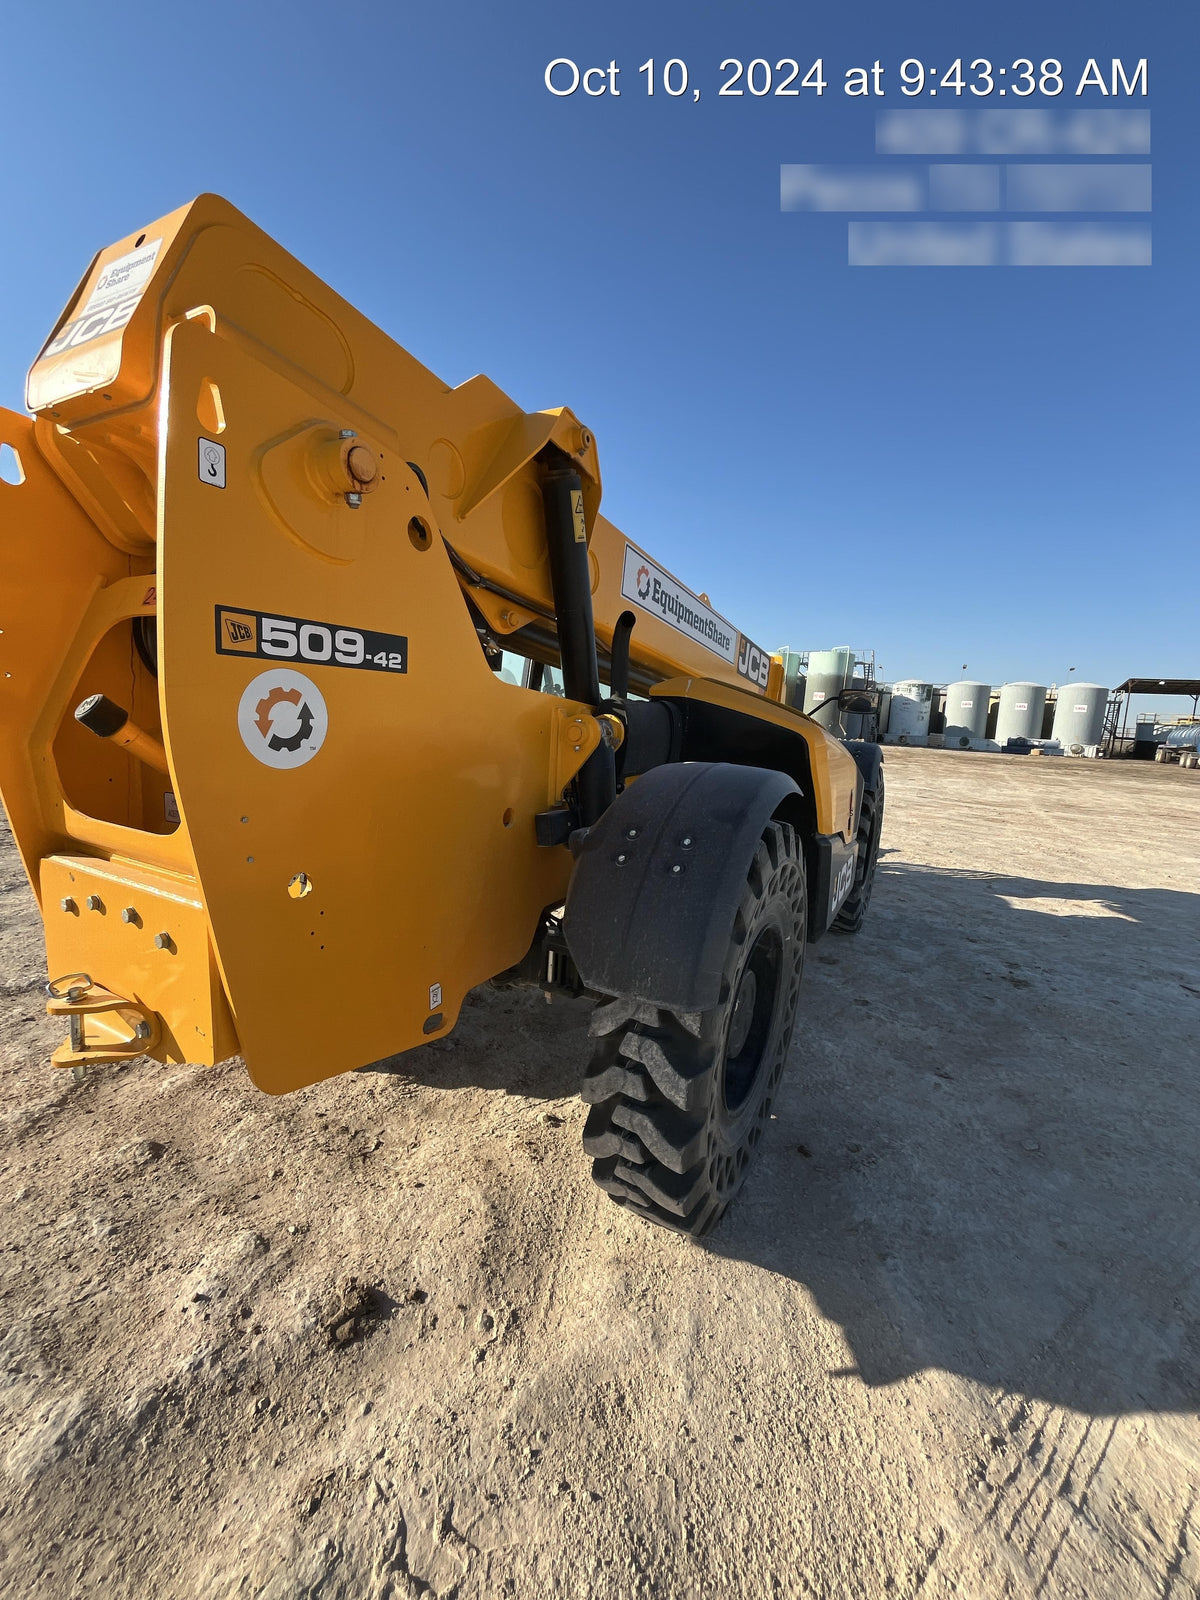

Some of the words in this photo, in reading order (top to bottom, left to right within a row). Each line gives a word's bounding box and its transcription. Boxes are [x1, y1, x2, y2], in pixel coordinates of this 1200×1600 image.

[105, 273, 130, 288] Share
[110, 252, 155, 278] Equipment
[45, 301, 138, 357] JCB
[651, 577, 730, 651] EquipmentShare
[229, 622, 253, 641] JCB
[261, 617, 402, 669] 509-42
[738, 641, 770, 687] JCB
[831, 854, 854, 912] JCB
